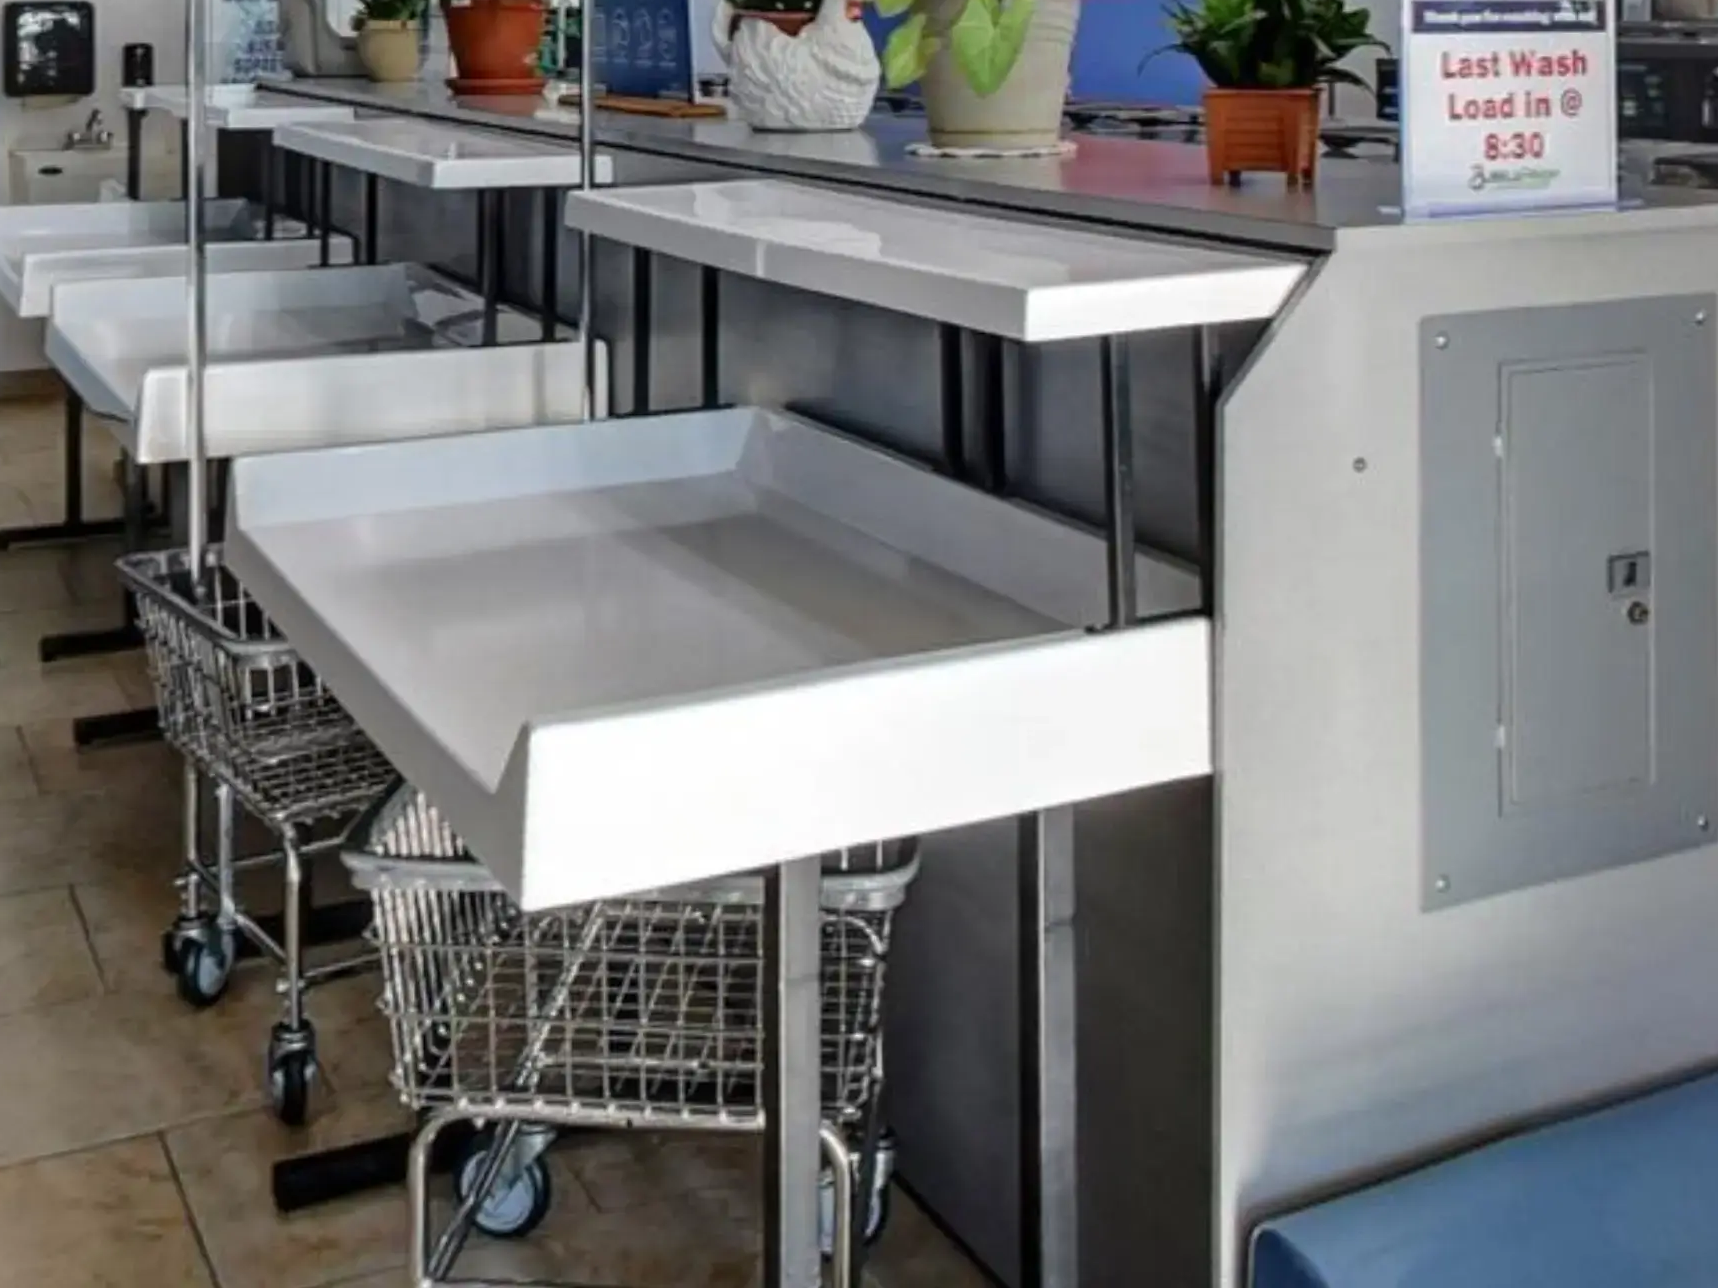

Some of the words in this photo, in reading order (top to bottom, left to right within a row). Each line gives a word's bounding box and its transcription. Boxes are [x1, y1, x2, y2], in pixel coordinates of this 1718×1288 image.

[1441, 51, 1502, 79] Last
[1508, 48, 1588, 77] Wash
[1448, 92, 1515, 120] Load
[1525, 91, 1552, 118] in
[1559, 88, 1583, 117] @
[1485, 132, 1544, 161] 8:30
